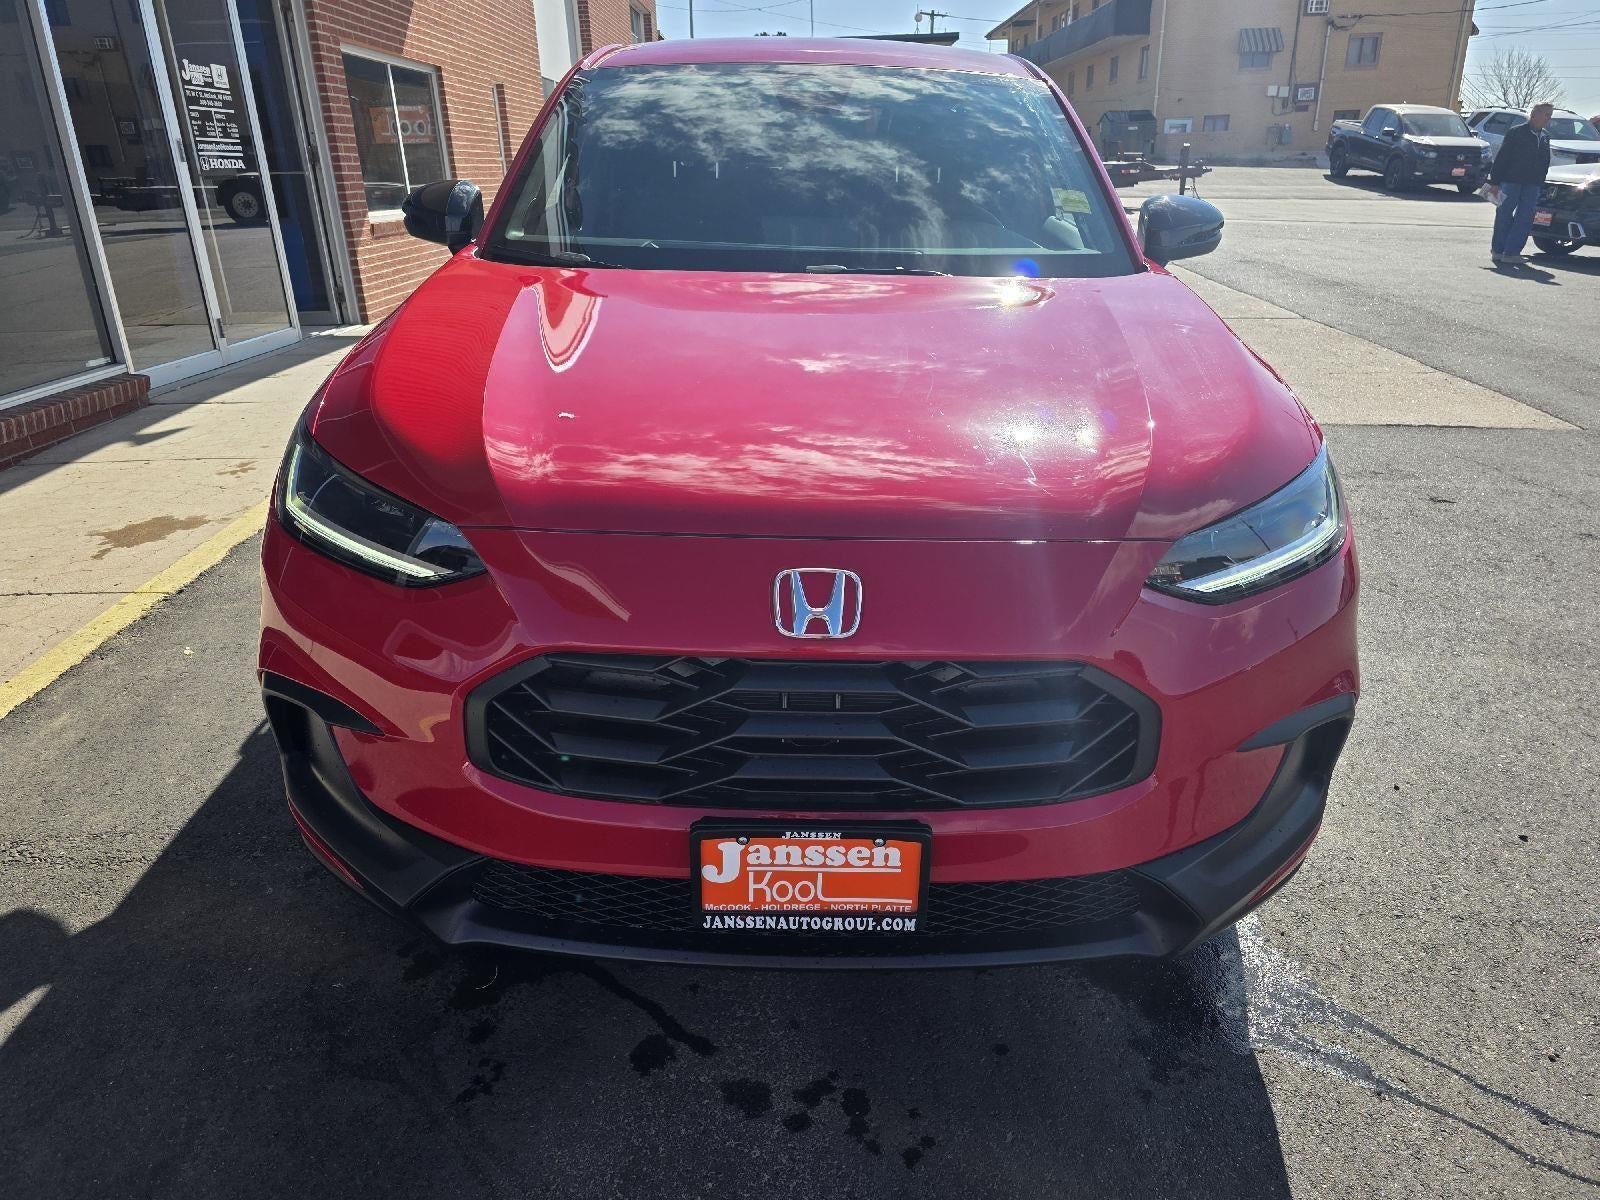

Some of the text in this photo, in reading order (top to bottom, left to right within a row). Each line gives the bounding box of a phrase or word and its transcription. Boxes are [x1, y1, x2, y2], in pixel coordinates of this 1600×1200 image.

[209, 159, 246, 169] HONDA
[781, 831, 842, 839] JANSSEN
[701, 842, 902, 883] Janssen
[704, 903, 751, 911] McCOOK
[761, 903, 821, 911] HOLDREGE
[830, 903, 868, 911] NORTH
[871, 904, 912, 912] PLATTE
